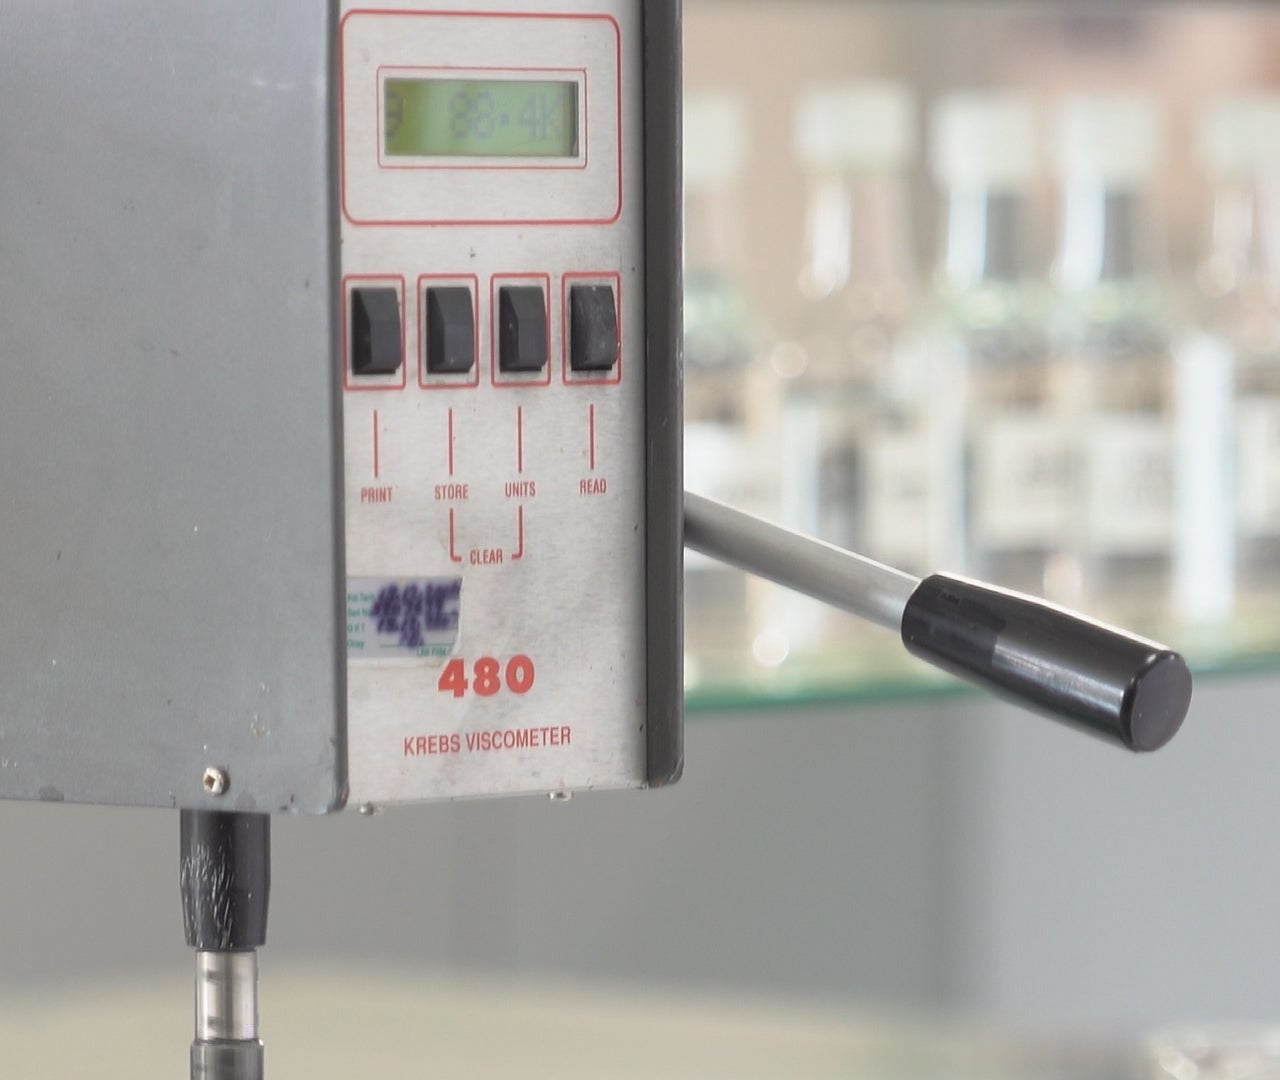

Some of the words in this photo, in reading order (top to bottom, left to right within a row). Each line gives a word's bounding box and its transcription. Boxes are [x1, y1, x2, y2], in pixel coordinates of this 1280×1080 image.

[360, 486, 392, 503] PRINT
[434, 483, 469, 500] STORE
[505, 480, 536, 497] UNITS
[579, 478, 607, 494] READ
[469, 548, 504, 565] CLEAR
[437, 654, 535, 698] 480
[403, 734, 461, 756] KREBS
[466, 725, 572, 751] VISCOMETER
